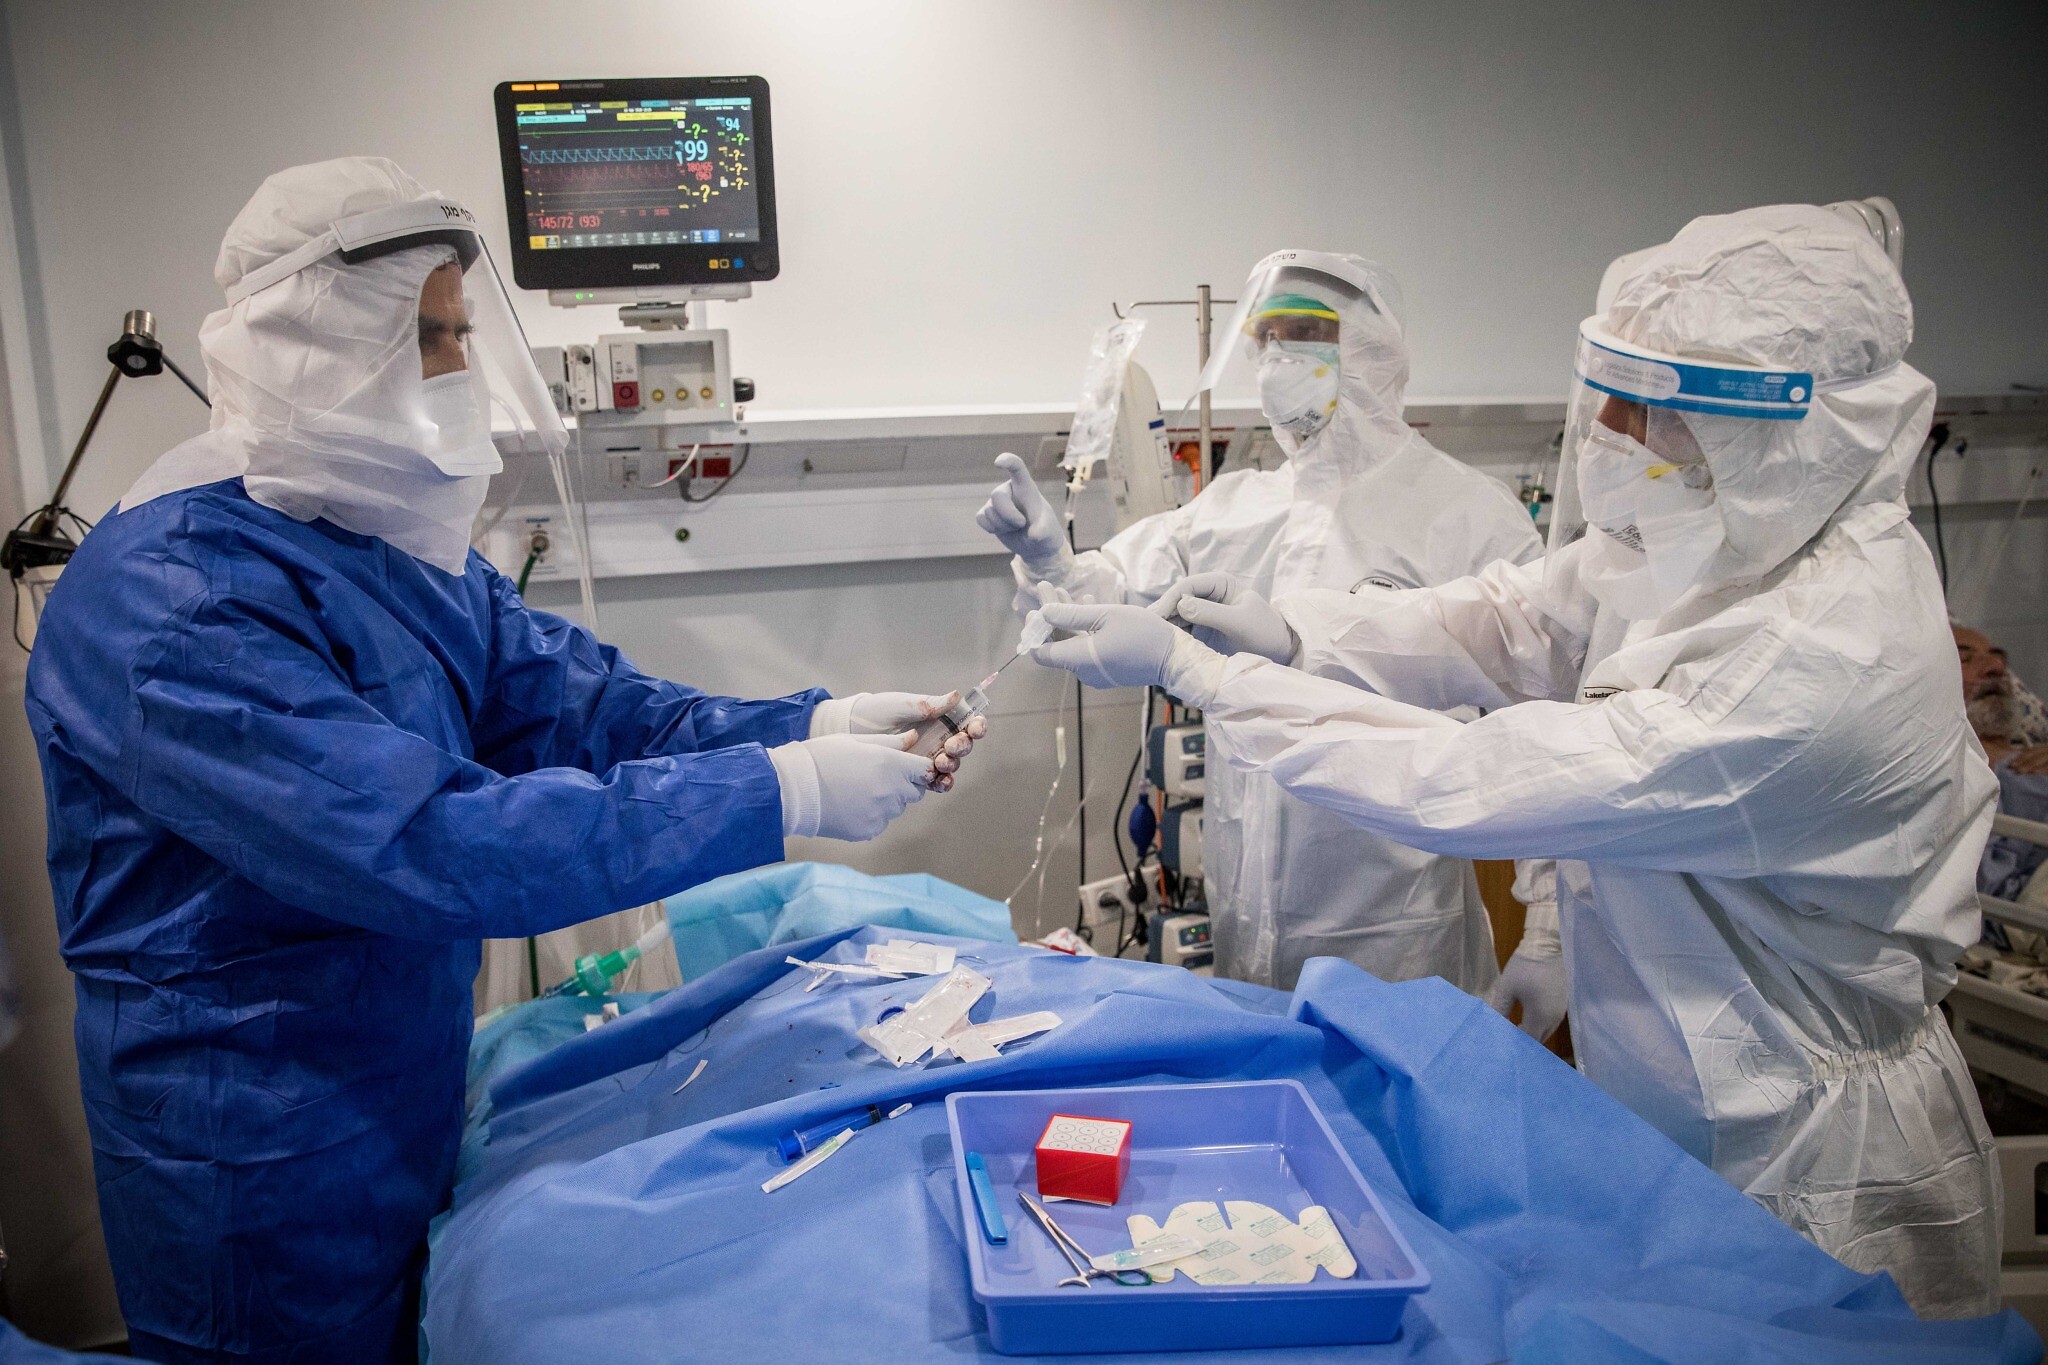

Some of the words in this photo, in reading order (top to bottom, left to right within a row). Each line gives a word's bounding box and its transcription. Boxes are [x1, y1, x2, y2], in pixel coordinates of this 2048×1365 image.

[725, 118, 740, 131] 94
[684, 140, 708, 161] 99
[440, 205, 460, 219] מגן
[539, 215, 574, 230] 145/72
[579, 215, 600, 228] (93)
[1585, 691, 1617, 699] Lakela
